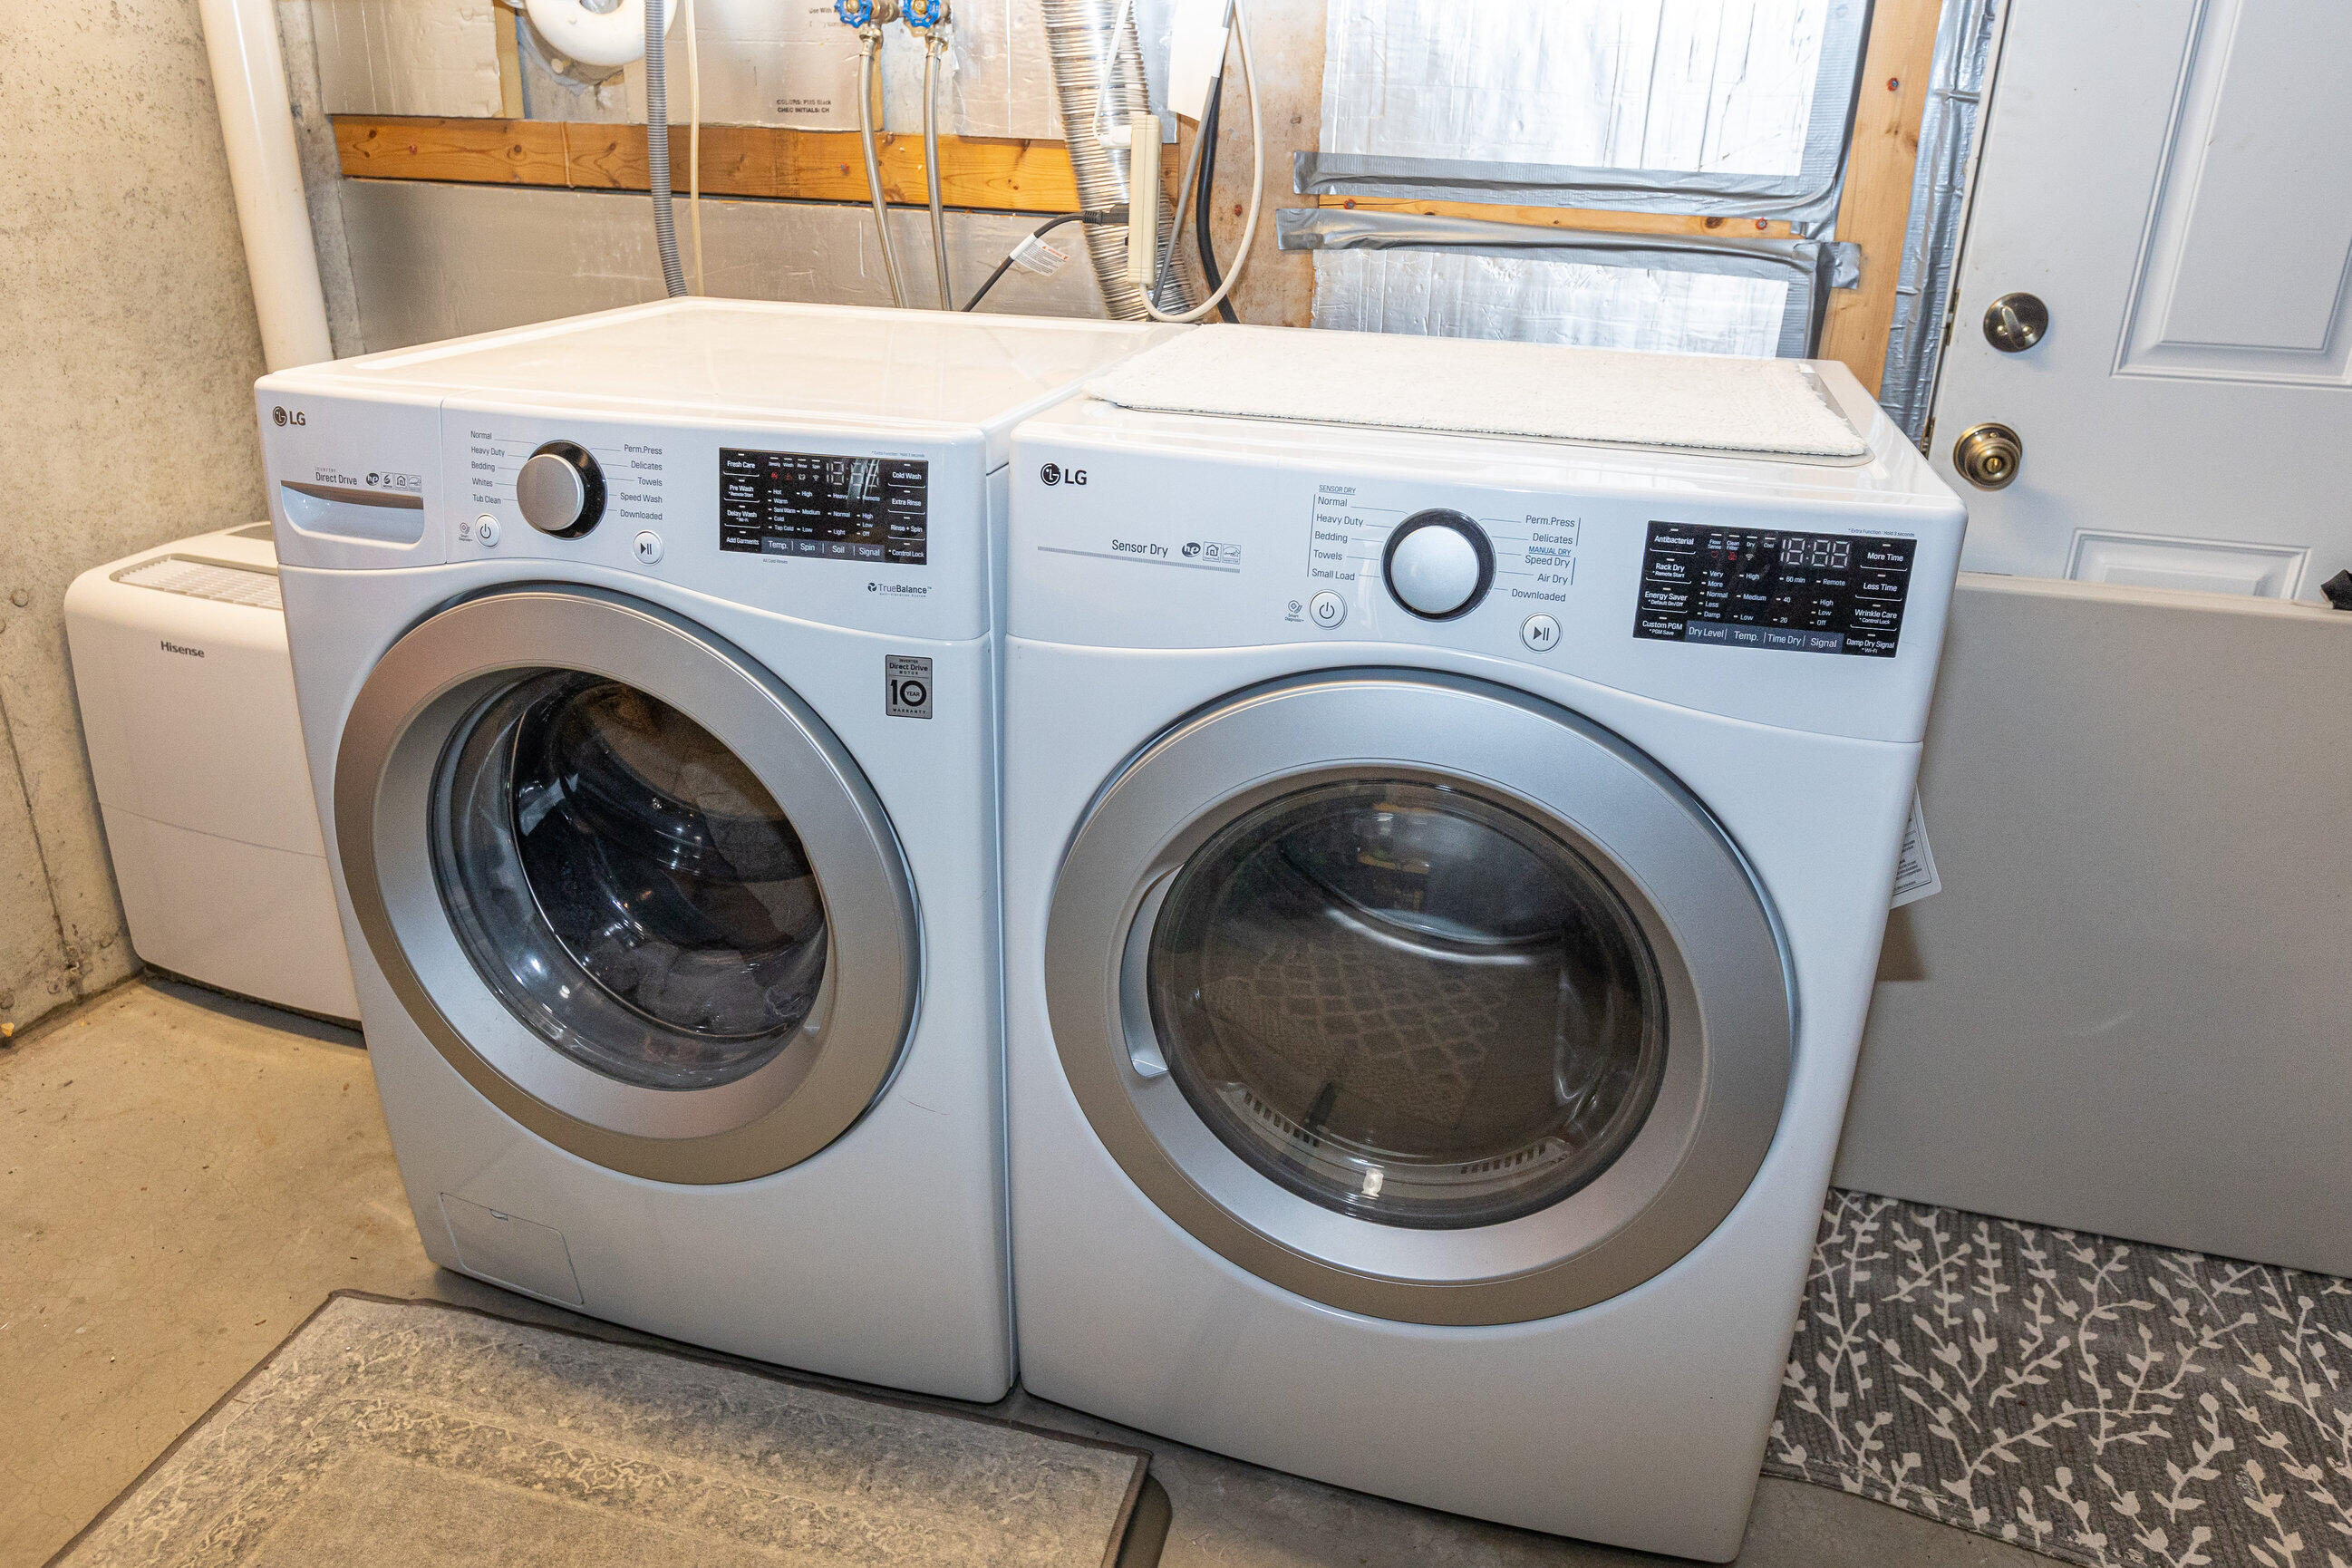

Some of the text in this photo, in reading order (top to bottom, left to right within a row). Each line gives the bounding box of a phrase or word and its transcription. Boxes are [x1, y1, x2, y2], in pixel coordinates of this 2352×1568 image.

[289, 411, 306, 426] LG
[470, 431, 492, 440] Normal
[470, 446, 505, 457] Heavy Duty
[471, 460, 496, 472] Bedding
[631, 460, 663, 471] Delicates
[315, 471, 357, 485] Direct Drive
[471, 477, 493, 487] Whites
[637, 476, 663, 487] Towels
[1064, 469, 1088, 486] LG
[1319, 484, 1357, 494] SENSOR DRY
[472, 494, 501, 505] Tub Clean
[620, 492, 663, 503] Speed Wash
[1317, 496, 1348, 507] Normal
[620, 509, 663, 520] Downloaded
[1316, 513, 1364, 528] Heavy Duty
[1525, 514, 1575, 528] Perm.Press
[1314, 530, 1348, 544] Bedding
[1532, 532, 1573, 545] Delicates
[1654, 535, 1694, 545] Antibacterial
[769, 540, 789, 549] Temp.
[800, 543, 815, 551] Spin
[832, 545, 845, 554] Soil
[1111, 538, 1168, 558] Sensor Dry
[858, 547, 880, 557] Signal
[891, 548, 911, 557] Control
[1313, 549, 1342, 561] Towels
[1528, 546, 1572, 556] MANUAL DRY
[1524, 555, 1571, 569] Speed Dry
[1867, 552, 1903, 562] More Time
[1655, 562, 1685, 573] Rack Dry
[1312, 568, 1355, 581] Small Load
[1537, 573, 1569, 586] Air Dry
[1709, 570, 1724, 578] Very
[1746, 573, 1760, 581] High
[1823, 578, 1845, 586] Remote
[1863, 582, 1898, 592] Less Time
[1511, 588, 1566, 602] Downloaded
[1644, 591, 1688, 601] Energy Saver
[1704, 611, 1721, 619] Damp
[1854, 608, 1898, 619] Wrinkle Care
[1642, 620, 1683, 630] Custom PGM
[1689, 626, 1724, 638] Dry Level
[1734, 630, 1758, 642] Temp.
[1767, 634, 1802, 646] Time Dry
[1810, 637, 1837, 648] Signal
[1846, 638, 1895, 650] Damp Dry Signal
[160, 640, 205, 658] Hisense
[890, 679, 927, 707] 10
